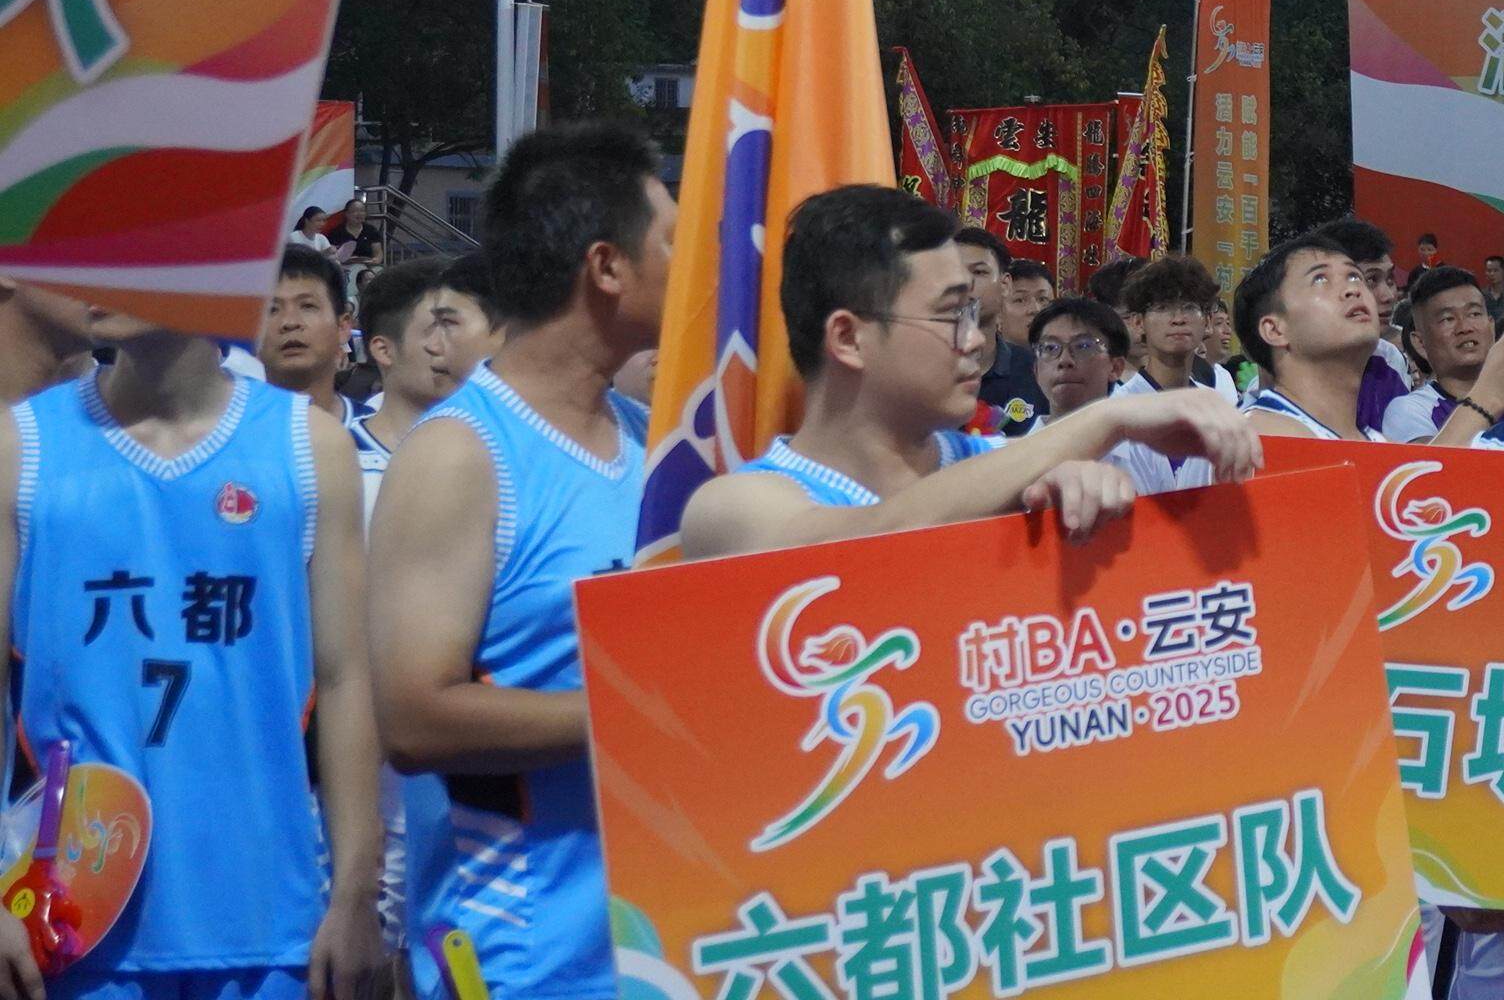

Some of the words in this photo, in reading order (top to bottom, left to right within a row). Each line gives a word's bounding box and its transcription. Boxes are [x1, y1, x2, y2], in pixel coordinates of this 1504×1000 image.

[84, 571, 257, 646] 六都
[138, 659, 192, 748] 7
[968, 680, 1103, 720] GORGEOUS
[1109, 650, 1260, 695] COUNTRYSIDE
[692, 788, 1359, 1000] 六都社区队
